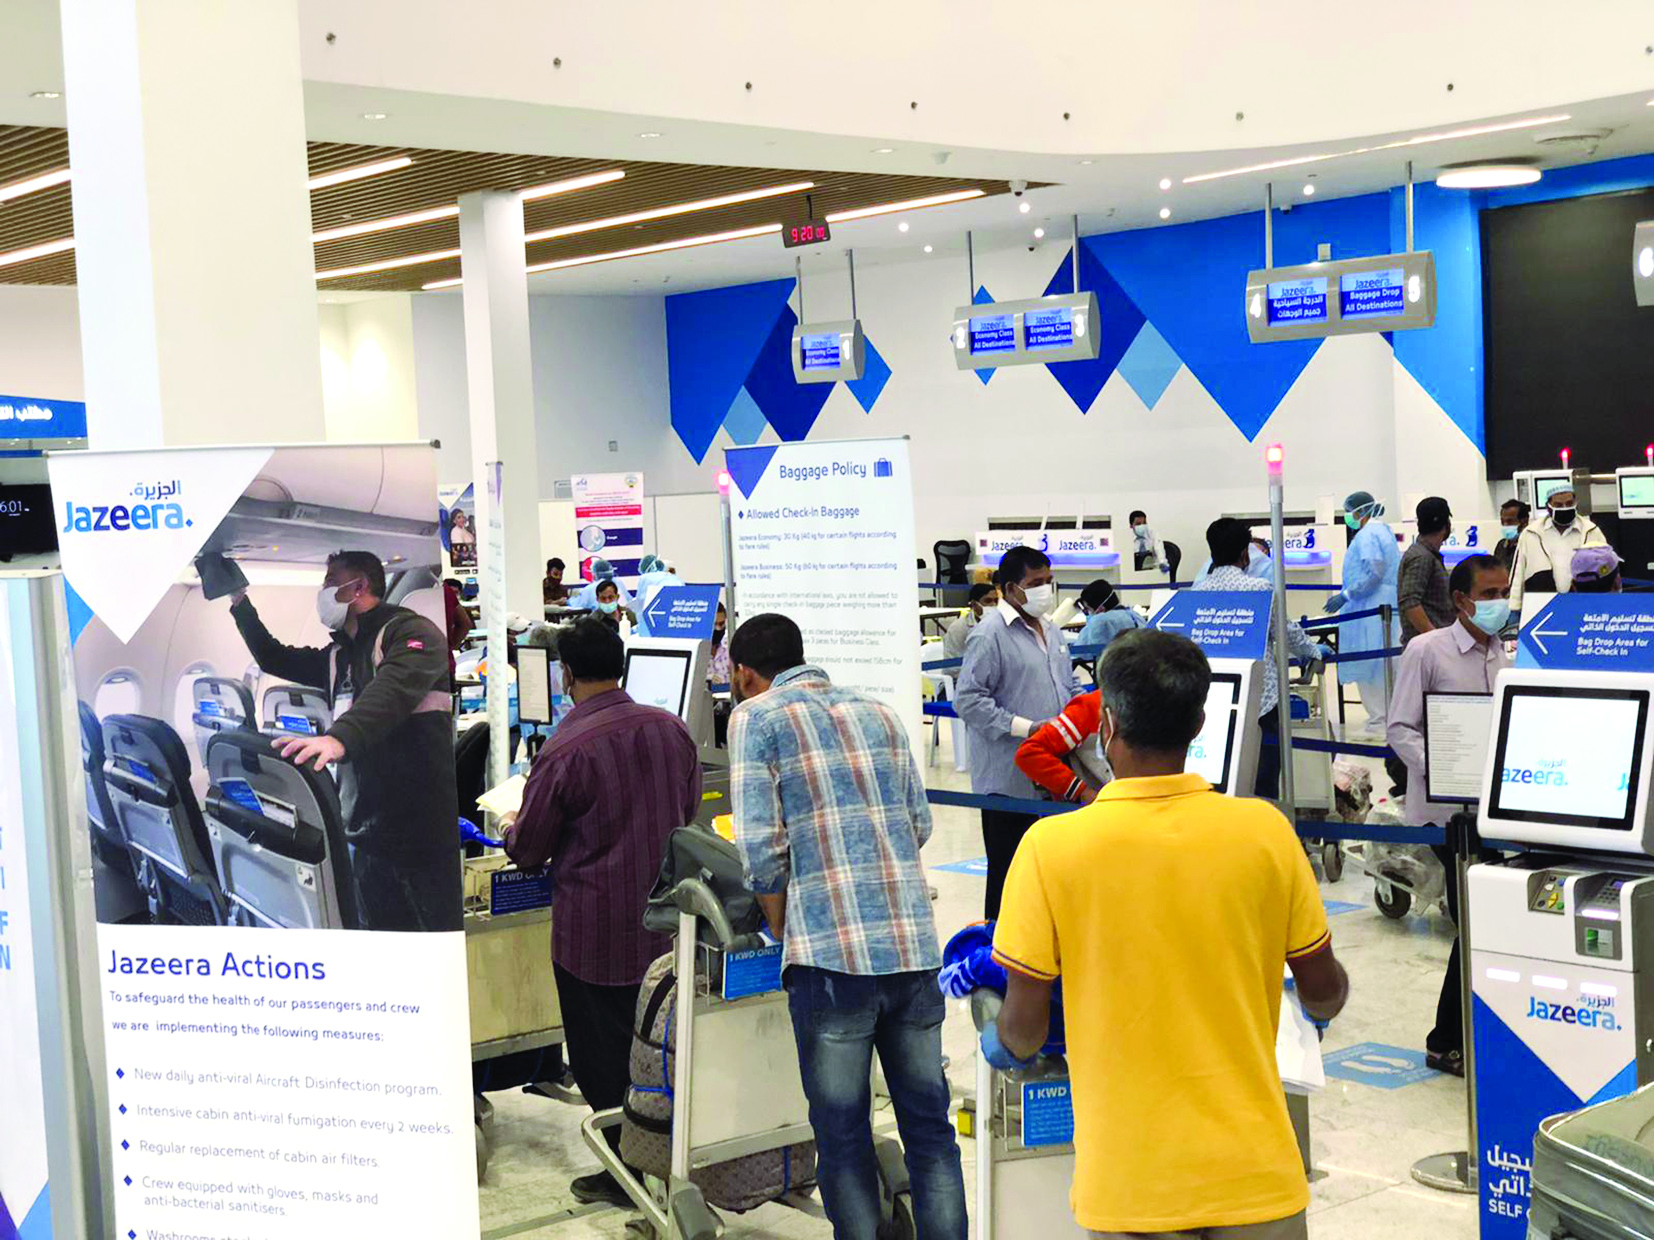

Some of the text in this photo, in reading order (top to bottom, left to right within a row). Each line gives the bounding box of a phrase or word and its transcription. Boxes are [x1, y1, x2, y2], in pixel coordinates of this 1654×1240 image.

[1350, 289, 1400, 301] Baggage Drop
[1346, 300, 1403, 312] All Destinations
[975, 330, 998, 340] Economy
[1030, 323, 1071, 334] Economy Class
[982, 340, 1015, 348] Destinations
[1038, 334, 1073, 342] Destinations
[779, 461, 867, 481] Baggage Policy
[746, 505, 860, 520] Allowed Check-In Baggage
[867, 531, 897, 540] according
[868, 562, 898, 571] according
[1578, 637, 1649, 647] Bag Drop Area for
[1576, 646, 1619, 656] Self-Check
[1501, 768, 1568, 786] azeera.
[501, 871, 523, 883] KWD
[108, 949, 326, 980] Jazeera Actions
[110, 990, 420, 1014] To safeguard the health of our passengers and crew
[112, 1020, 384, 1042] we are implementing the following measures:
[134, 1068, 442, 1097] New daily anti-viral Aircraft Disinfection program.
[1028, 1086, 1067, 1100] 1 KWD
[137, 1104, 454, 1134] Intensive cabin anti-viral fumigation every 2 weeks.
[139, 1139, 381, 1168] Regular replacement of cabin air filters.
[142, 1175, 379, 1205] Crew equipped with gloves, masks and
[144, 1196, 288, 1216] anti-bacterial sanitisers.
[1488, 1199, 1523, 1218] SELF
